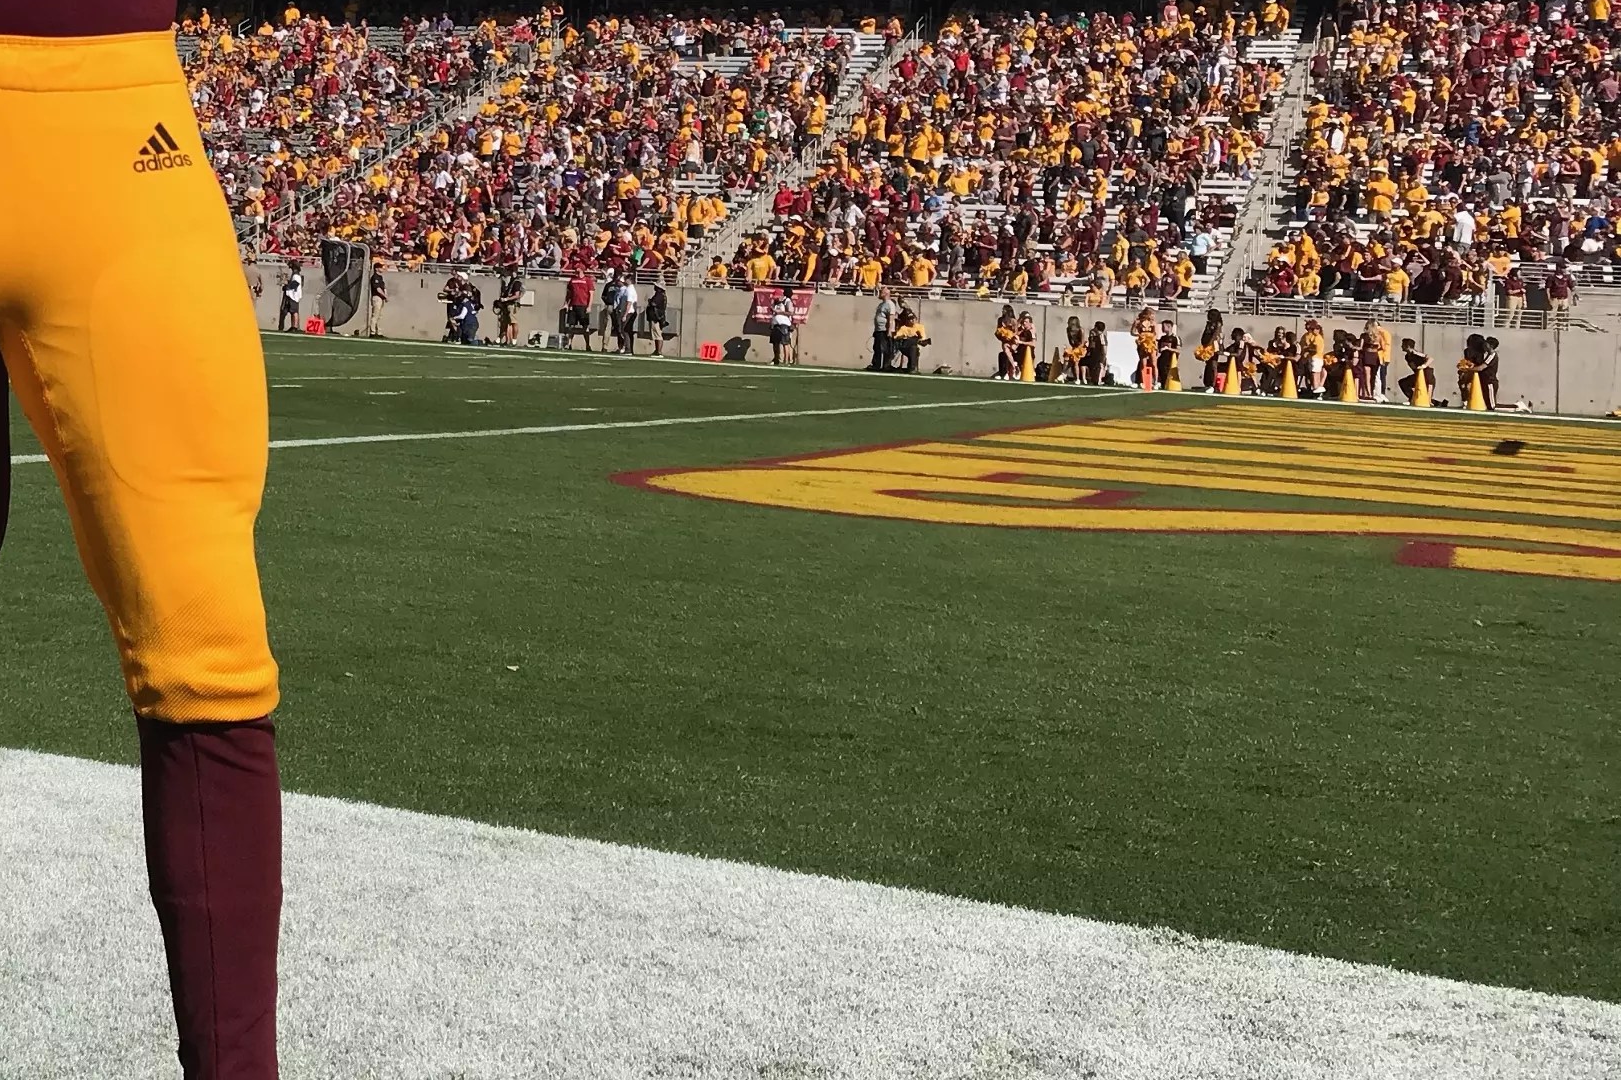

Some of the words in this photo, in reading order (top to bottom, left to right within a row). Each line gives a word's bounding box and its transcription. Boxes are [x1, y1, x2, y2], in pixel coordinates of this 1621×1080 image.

[132, 151, 193, 173] adidas
[306, 320, 321, 332] 20
[703, 345, 718, 359] 10
